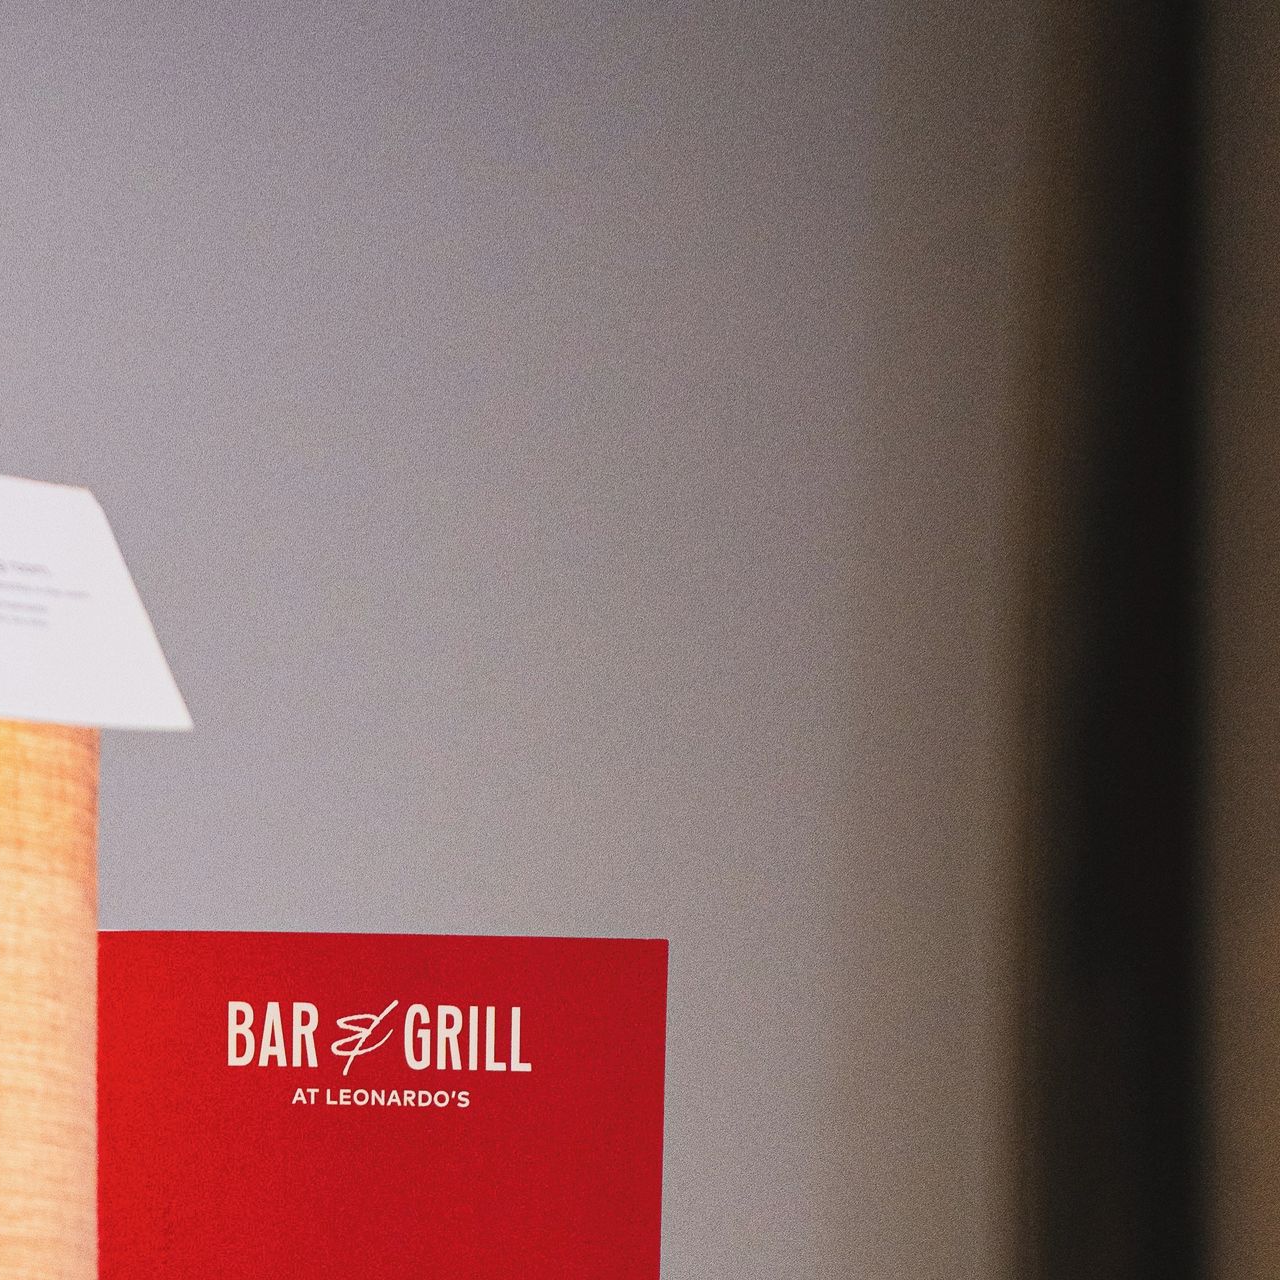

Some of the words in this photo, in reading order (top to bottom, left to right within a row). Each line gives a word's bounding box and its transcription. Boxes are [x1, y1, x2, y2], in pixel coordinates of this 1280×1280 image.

[227, 1001, 318, 1068] BAR
[330, 999, 400, 1076] &
[404, 1003, 532, 1073] GRILL
[291, 1087, 320, 1105] AT
[326, 1088, 470, 1108] LEONARDO'S
